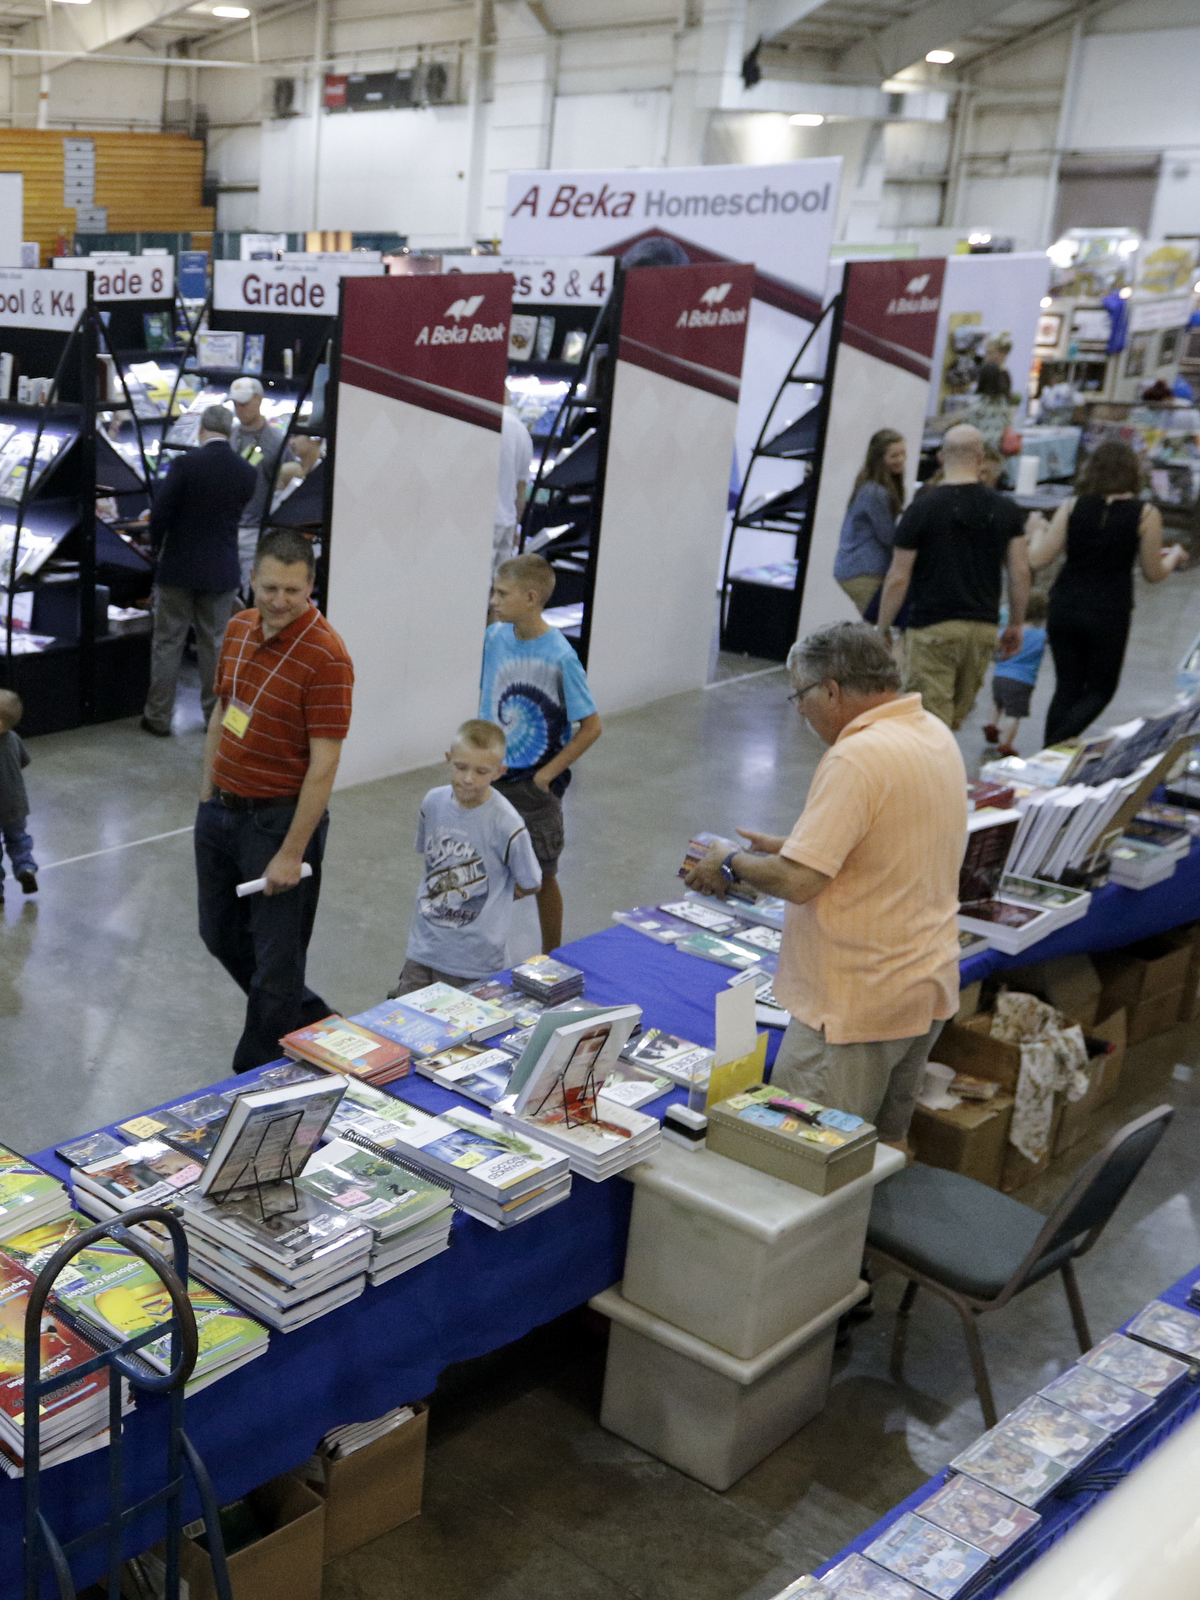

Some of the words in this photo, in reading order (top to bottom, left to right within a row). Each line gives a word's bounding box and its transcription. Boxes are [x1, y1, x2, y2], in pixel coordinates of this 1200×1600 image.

[511, 185, 540, 218] A
[549, 184, 636, 218] Beka
[643, 183, 832, 218] Homeschool
[96, 268, 142, 295] ade
[151, 268, 163, 293] 8
[242, 273, 325, 308] Grade
[541, 271, 555, 297] 3
[565, 271, 582, 298] &
[590, 271, 607, 297] 4
[32, 290, 44, 315] &
[51, 292, 76, 317] K4
[676, 310, 688, 328] A
[689, 309, 719, 327] Beka
[720, 307, 747, 327] Book
[415, 327, 430, 346] A
[433, 326, 469, 345] Beka
[471, 322, 507, 343] Book
[488, 1159, 527, 1181] ADVANCED
[101, 1259, 145, 1282] Exploring
[64, 1277, 104, 1300] Creation
[40, 1354, 72, 1374] Explorin
[40, 1377, 85, 1405] ANATOM
